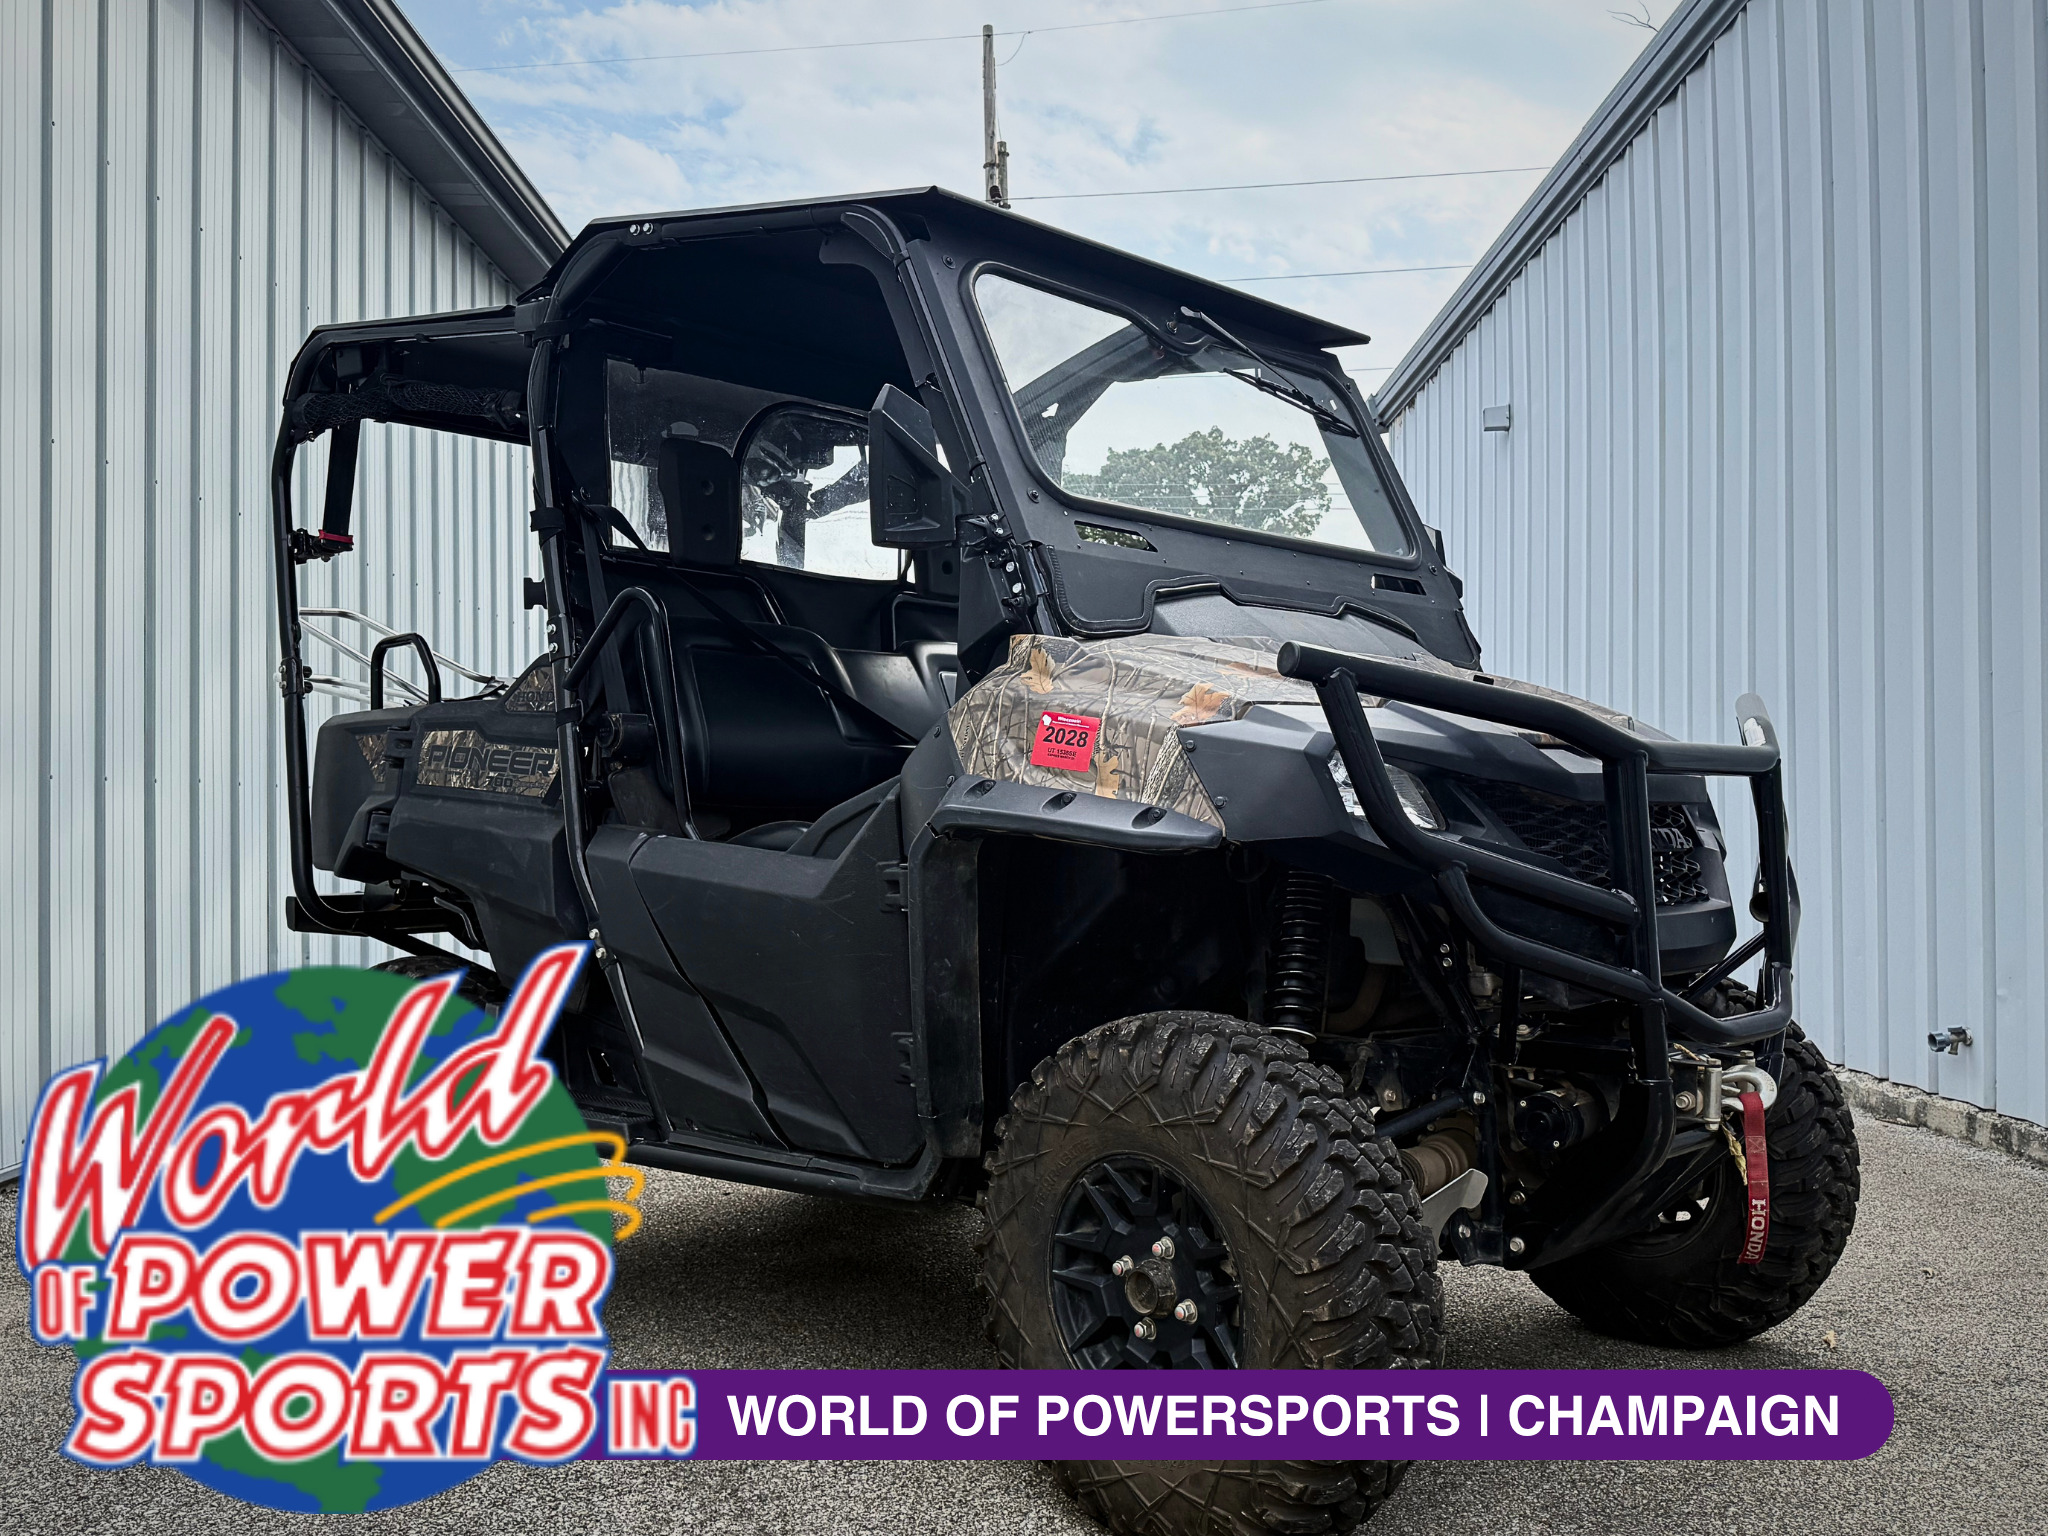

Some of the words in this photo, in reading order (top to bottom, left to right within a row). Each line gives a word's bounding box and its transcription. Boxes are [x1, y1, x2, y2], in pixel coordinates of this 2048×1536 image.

[517, 690, 554, 702] HOND
[1042, 726, 1089, 748] 2028
[427, 744, 555, 777] PIONEER
[1743, 1198, 1767, 1260] HONDA
